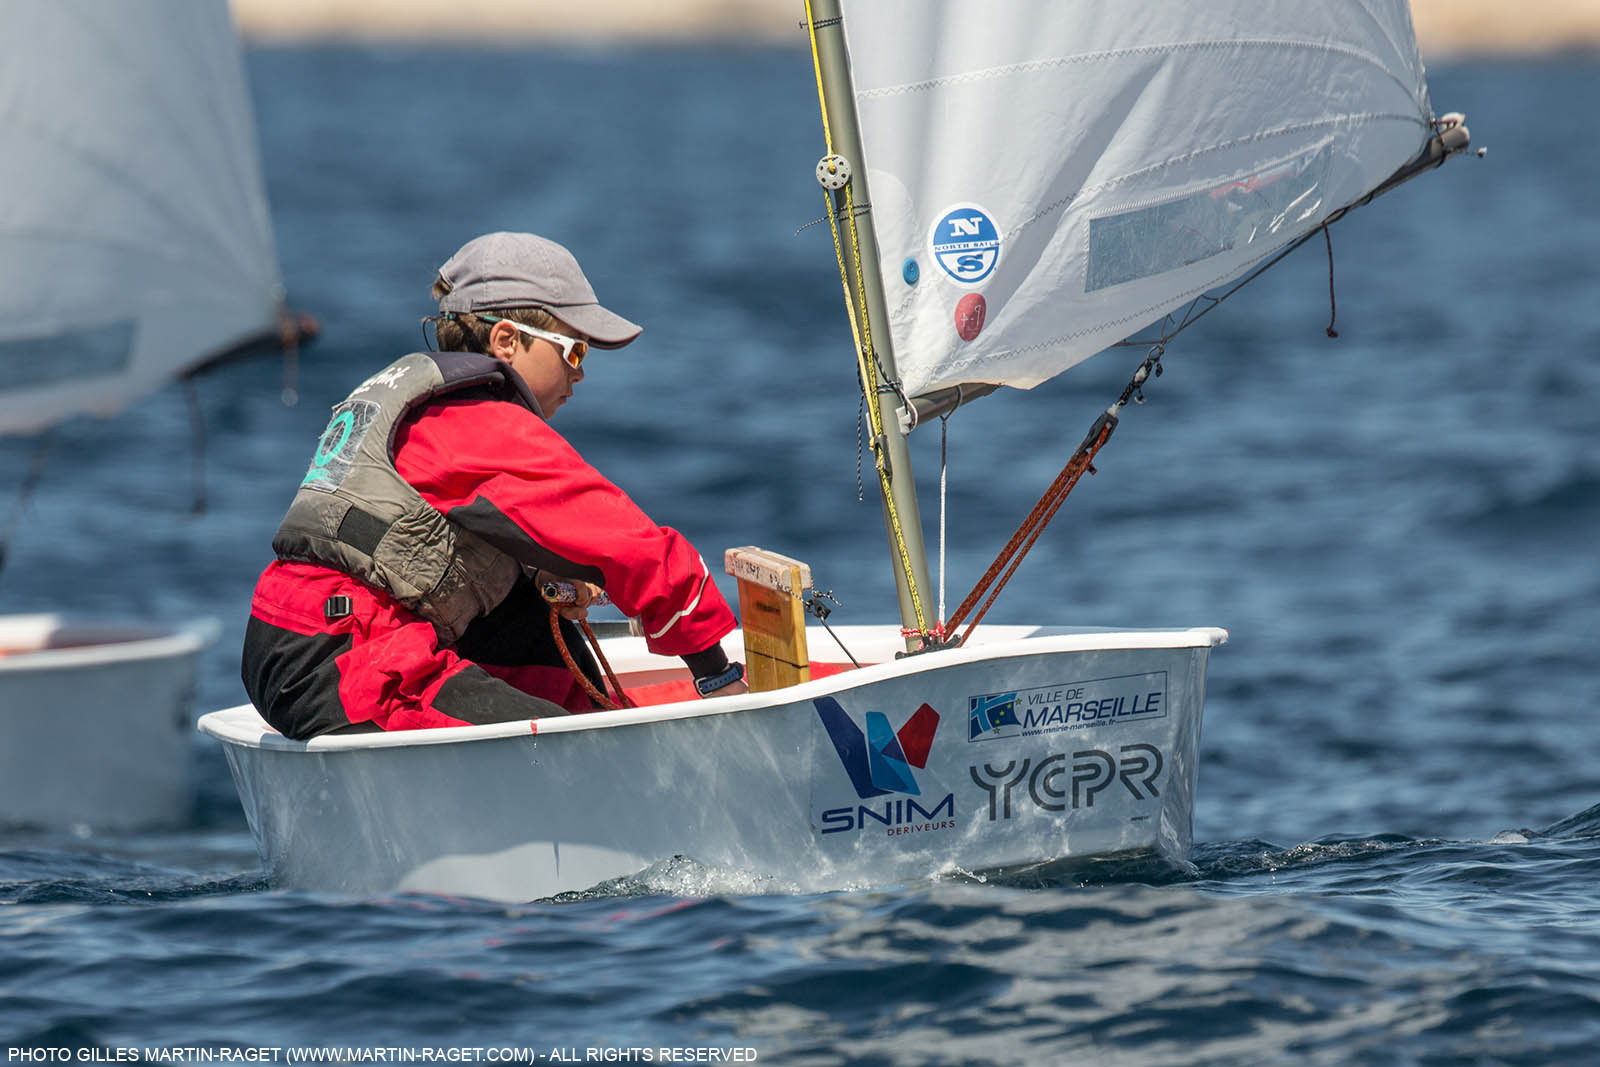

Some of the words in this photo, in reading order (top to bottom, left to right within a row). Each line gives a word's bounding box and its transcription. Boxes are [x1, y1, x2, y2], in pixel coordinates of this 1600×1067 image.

[948, 217, 983, 237] N
[934, 242, 969, 251] NORTH
[956, 253, 984, 273] S
[1028, 690, 1063, 706] VILLE
[1065, 687, 1085, 700] DE
[1023, 692, 1162, 729] MARSEILLE
[969, 744, 1163, 821] YCPR
[821, 792, 954, 835] SNIM
[887, 820, 956, 837] DERIVEURS
